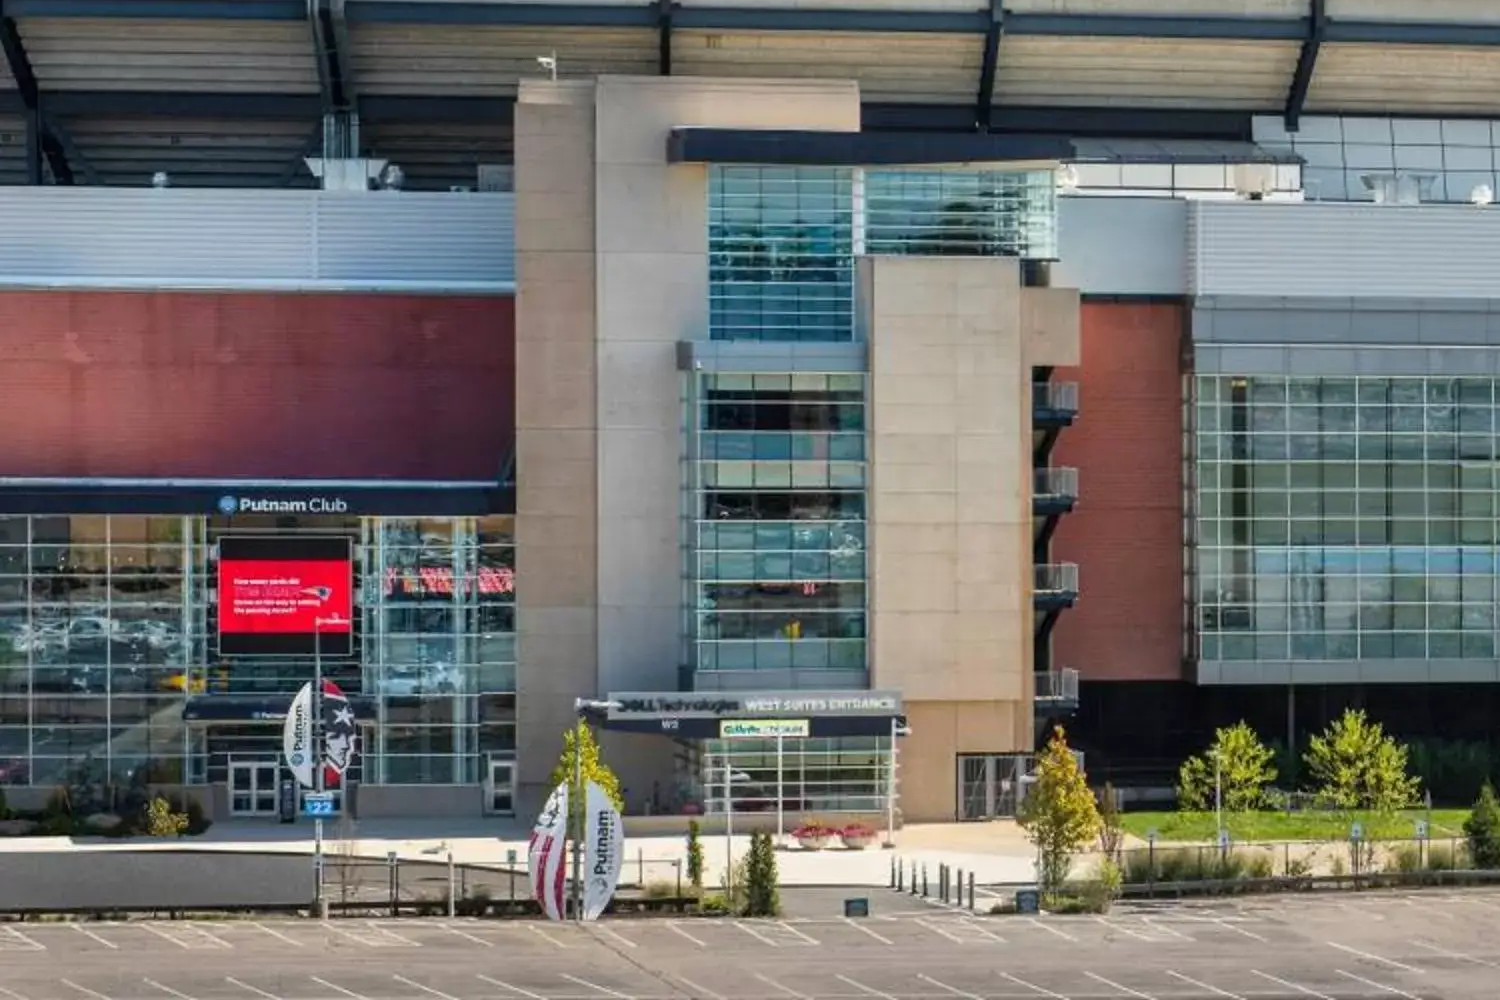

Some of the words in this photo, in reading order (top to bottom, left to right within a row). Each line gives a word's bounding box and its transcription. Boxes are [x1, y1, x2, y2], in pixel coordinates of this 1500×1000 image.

[240, 498, 306, 511] Putnam
[309, 497, 348, 512] Club
[745, 696, 780, 711] WEST
[784, 696, 827, 711] SUITES
[829, 695, 896, 710] ENTRANCE
[293, 704, 303, 751] Putnam
[593, 810, 608, 875] Putnam
